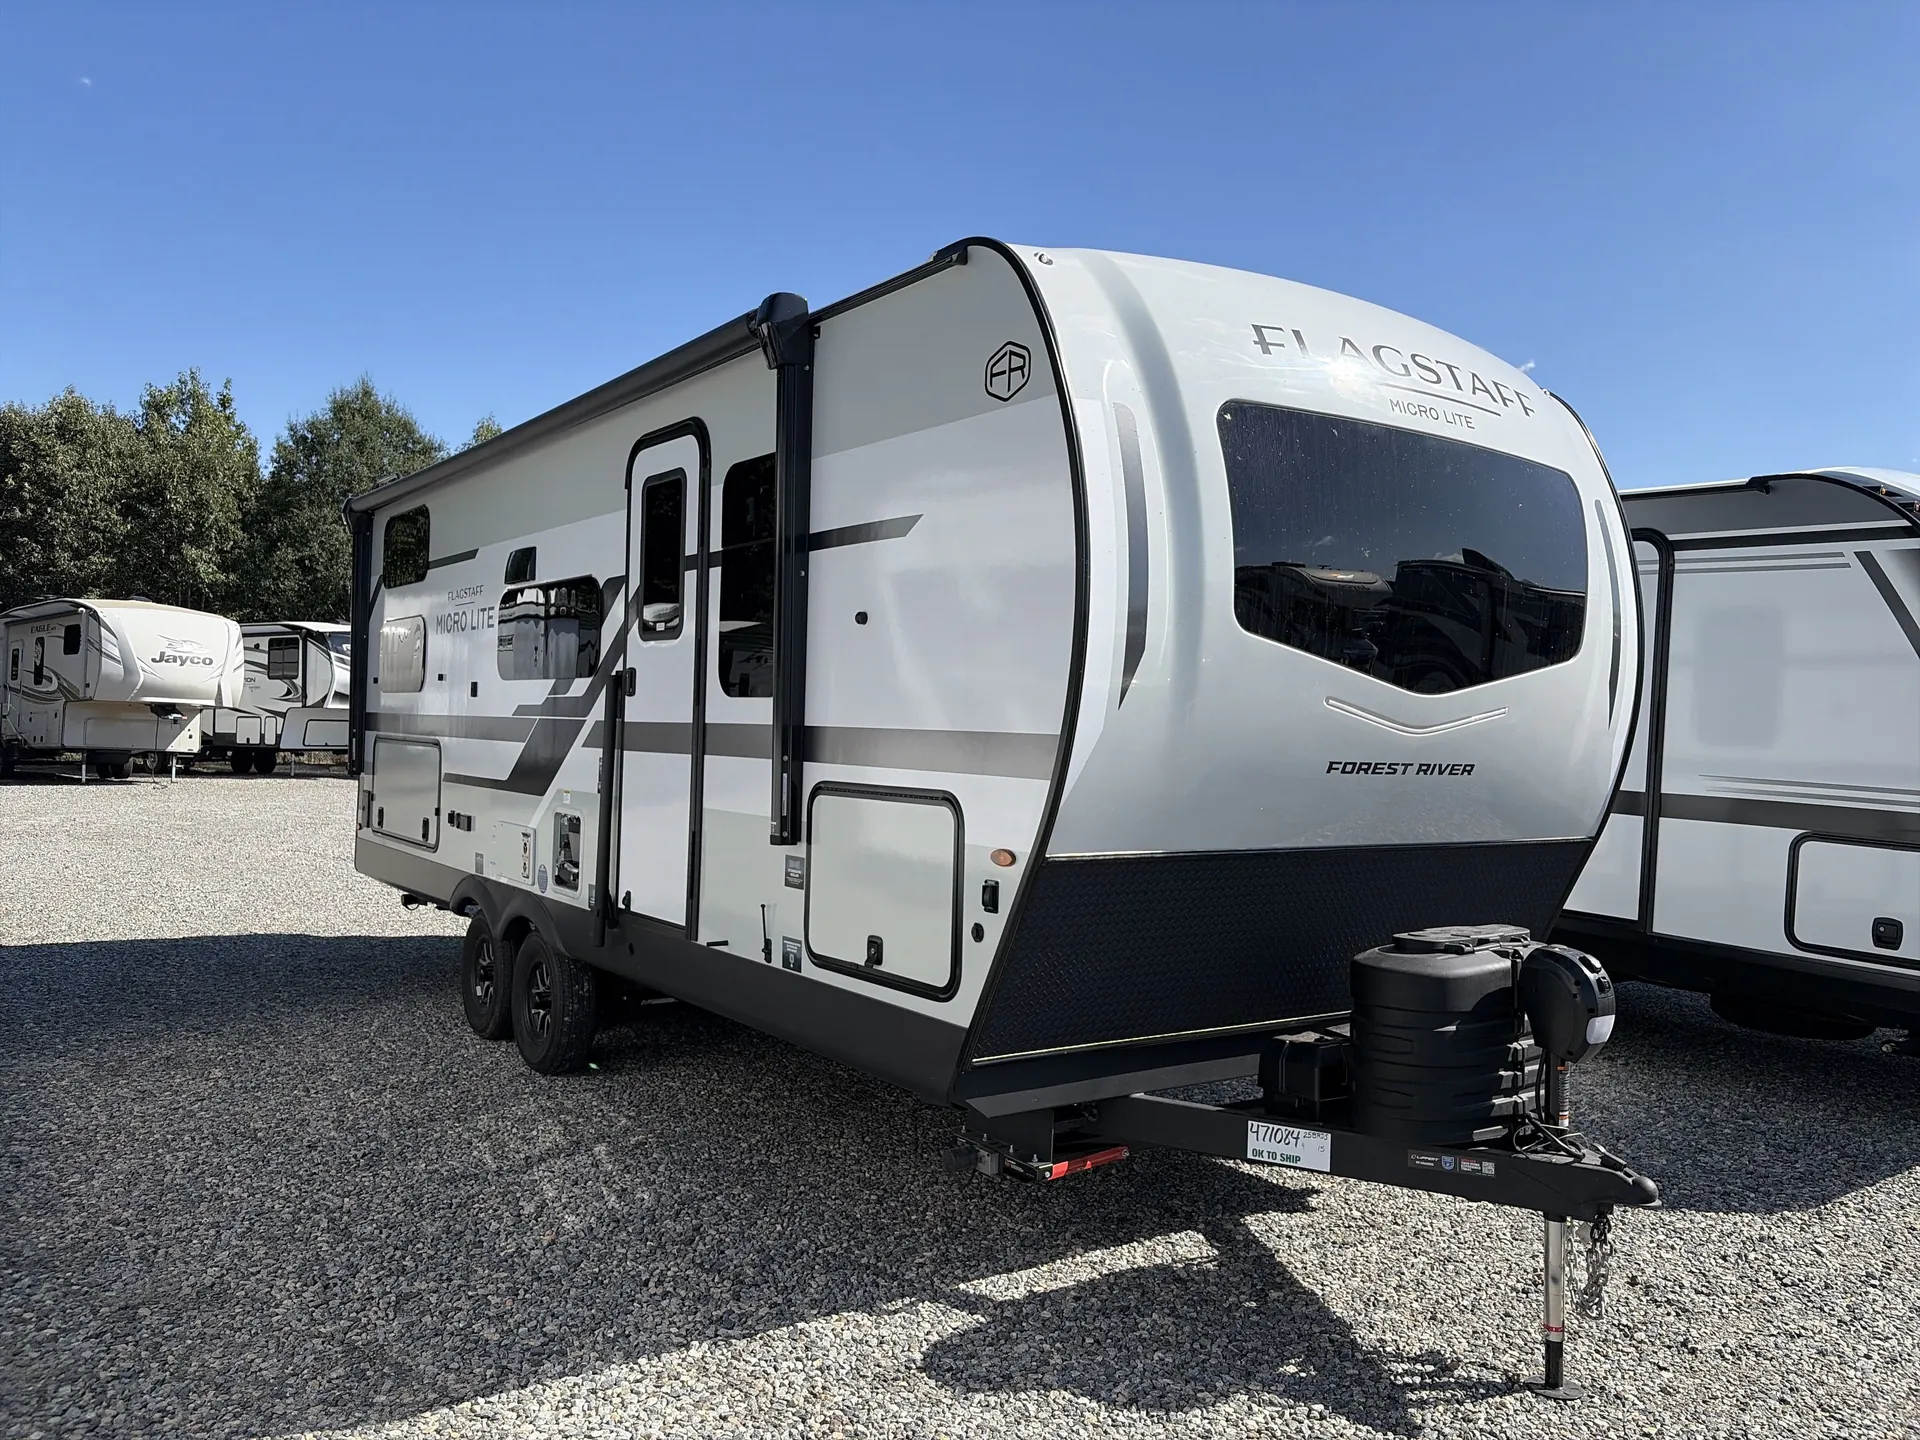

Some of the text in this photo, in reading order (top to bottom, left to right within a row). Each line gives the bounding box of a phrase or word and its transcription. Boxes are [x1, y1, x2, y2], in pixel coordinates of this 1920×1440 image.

[1250, 323, 1536, 417] FLAGSTAFF
[1389, 398, 1476, 430] MICRO LITE
[447, 584, 484, 601] FLAGSTAFF
[436, 610, 467, 635] MICRO
[470, 606, 495, 631] LITE
[151, 651, 214, 667] Jayco
[1325, 761, 1476, 776] FOREST RIVER
[1250, 1123, 1300, 1149] 471084
[1252, 1148, 1301, 1164] OK TO SHIP
